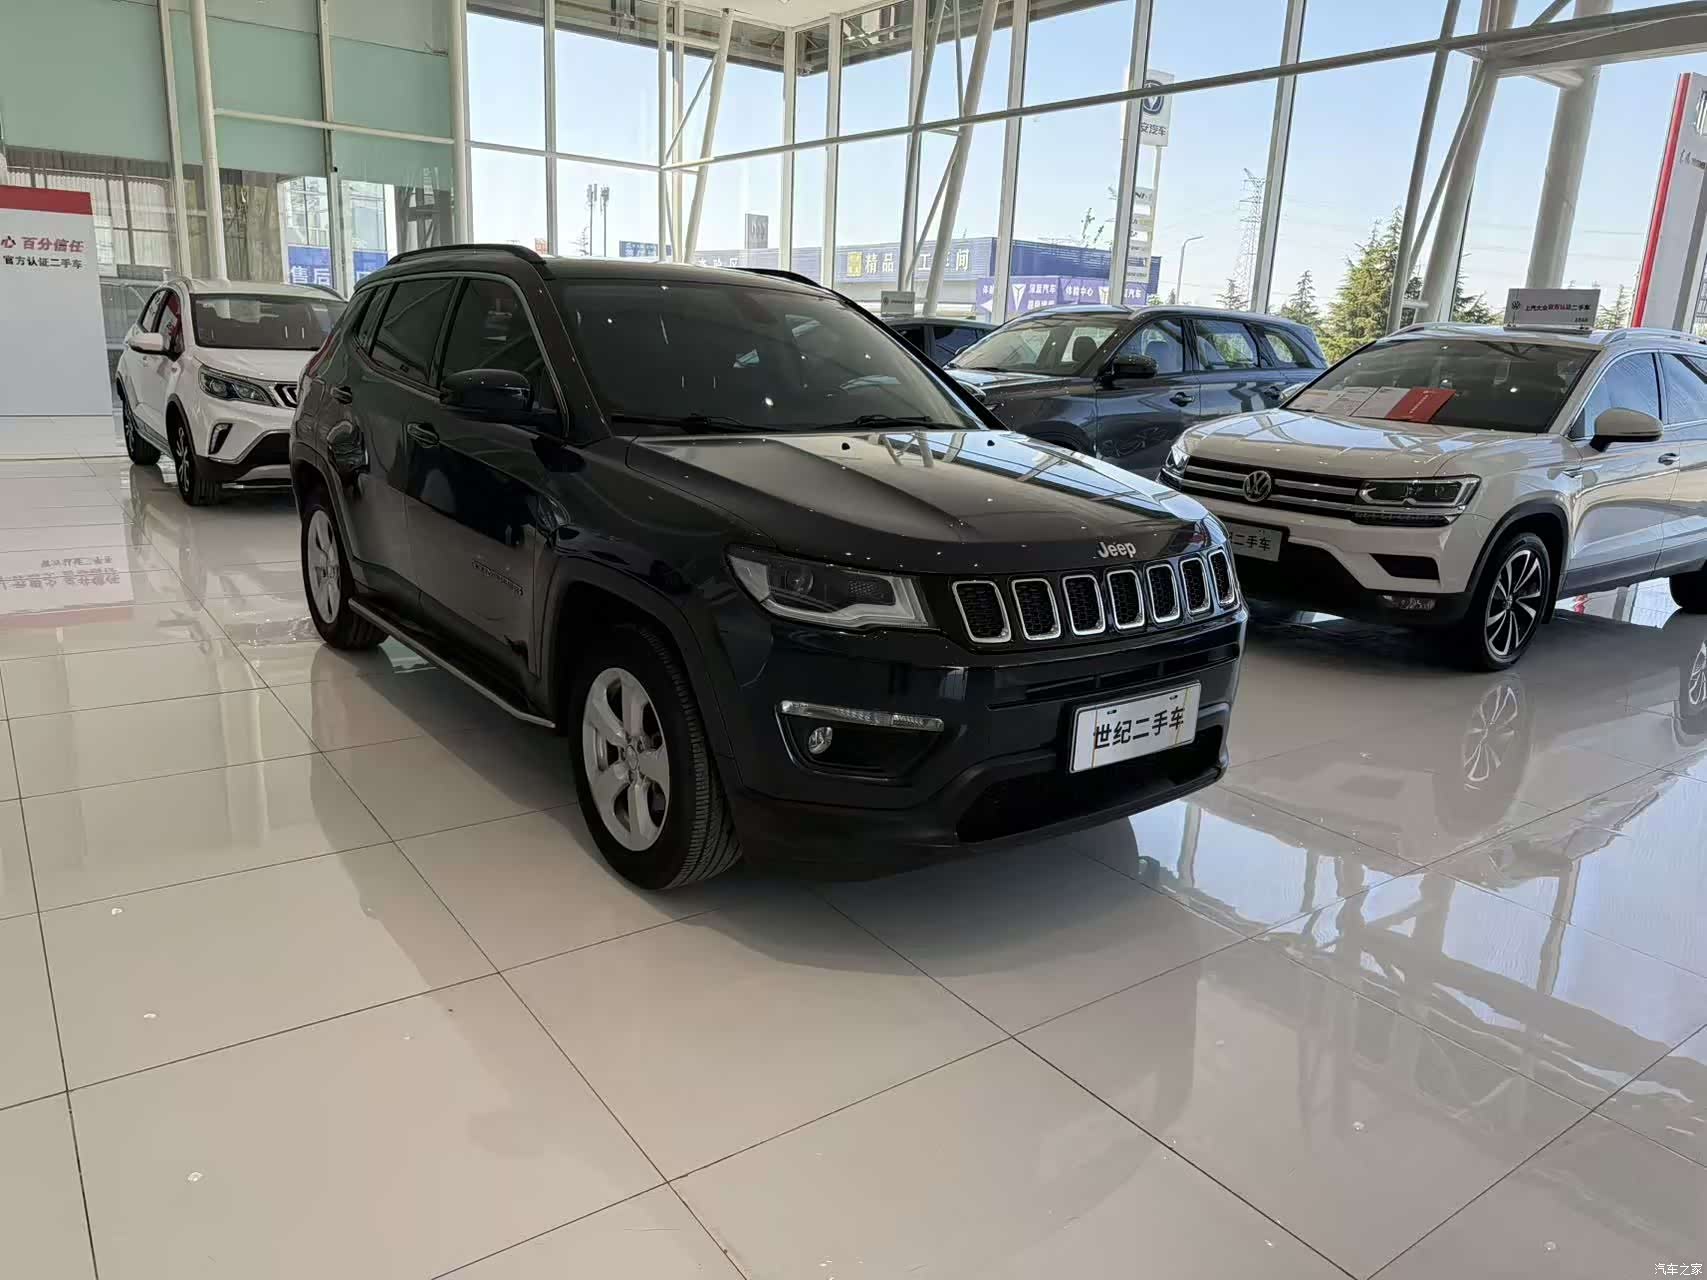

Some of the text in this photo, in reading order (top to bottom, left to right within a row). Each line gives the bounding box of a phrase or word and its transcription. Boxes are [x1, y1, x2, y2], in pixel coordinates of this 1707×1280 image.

[21, 236, 85, 253] 百分信任
[3, 255, 83, 270] 官方认证二手车
[1098, 541, 1137, 559] Jeep
[1094, 706, 1185, 750] 世纪二手车
